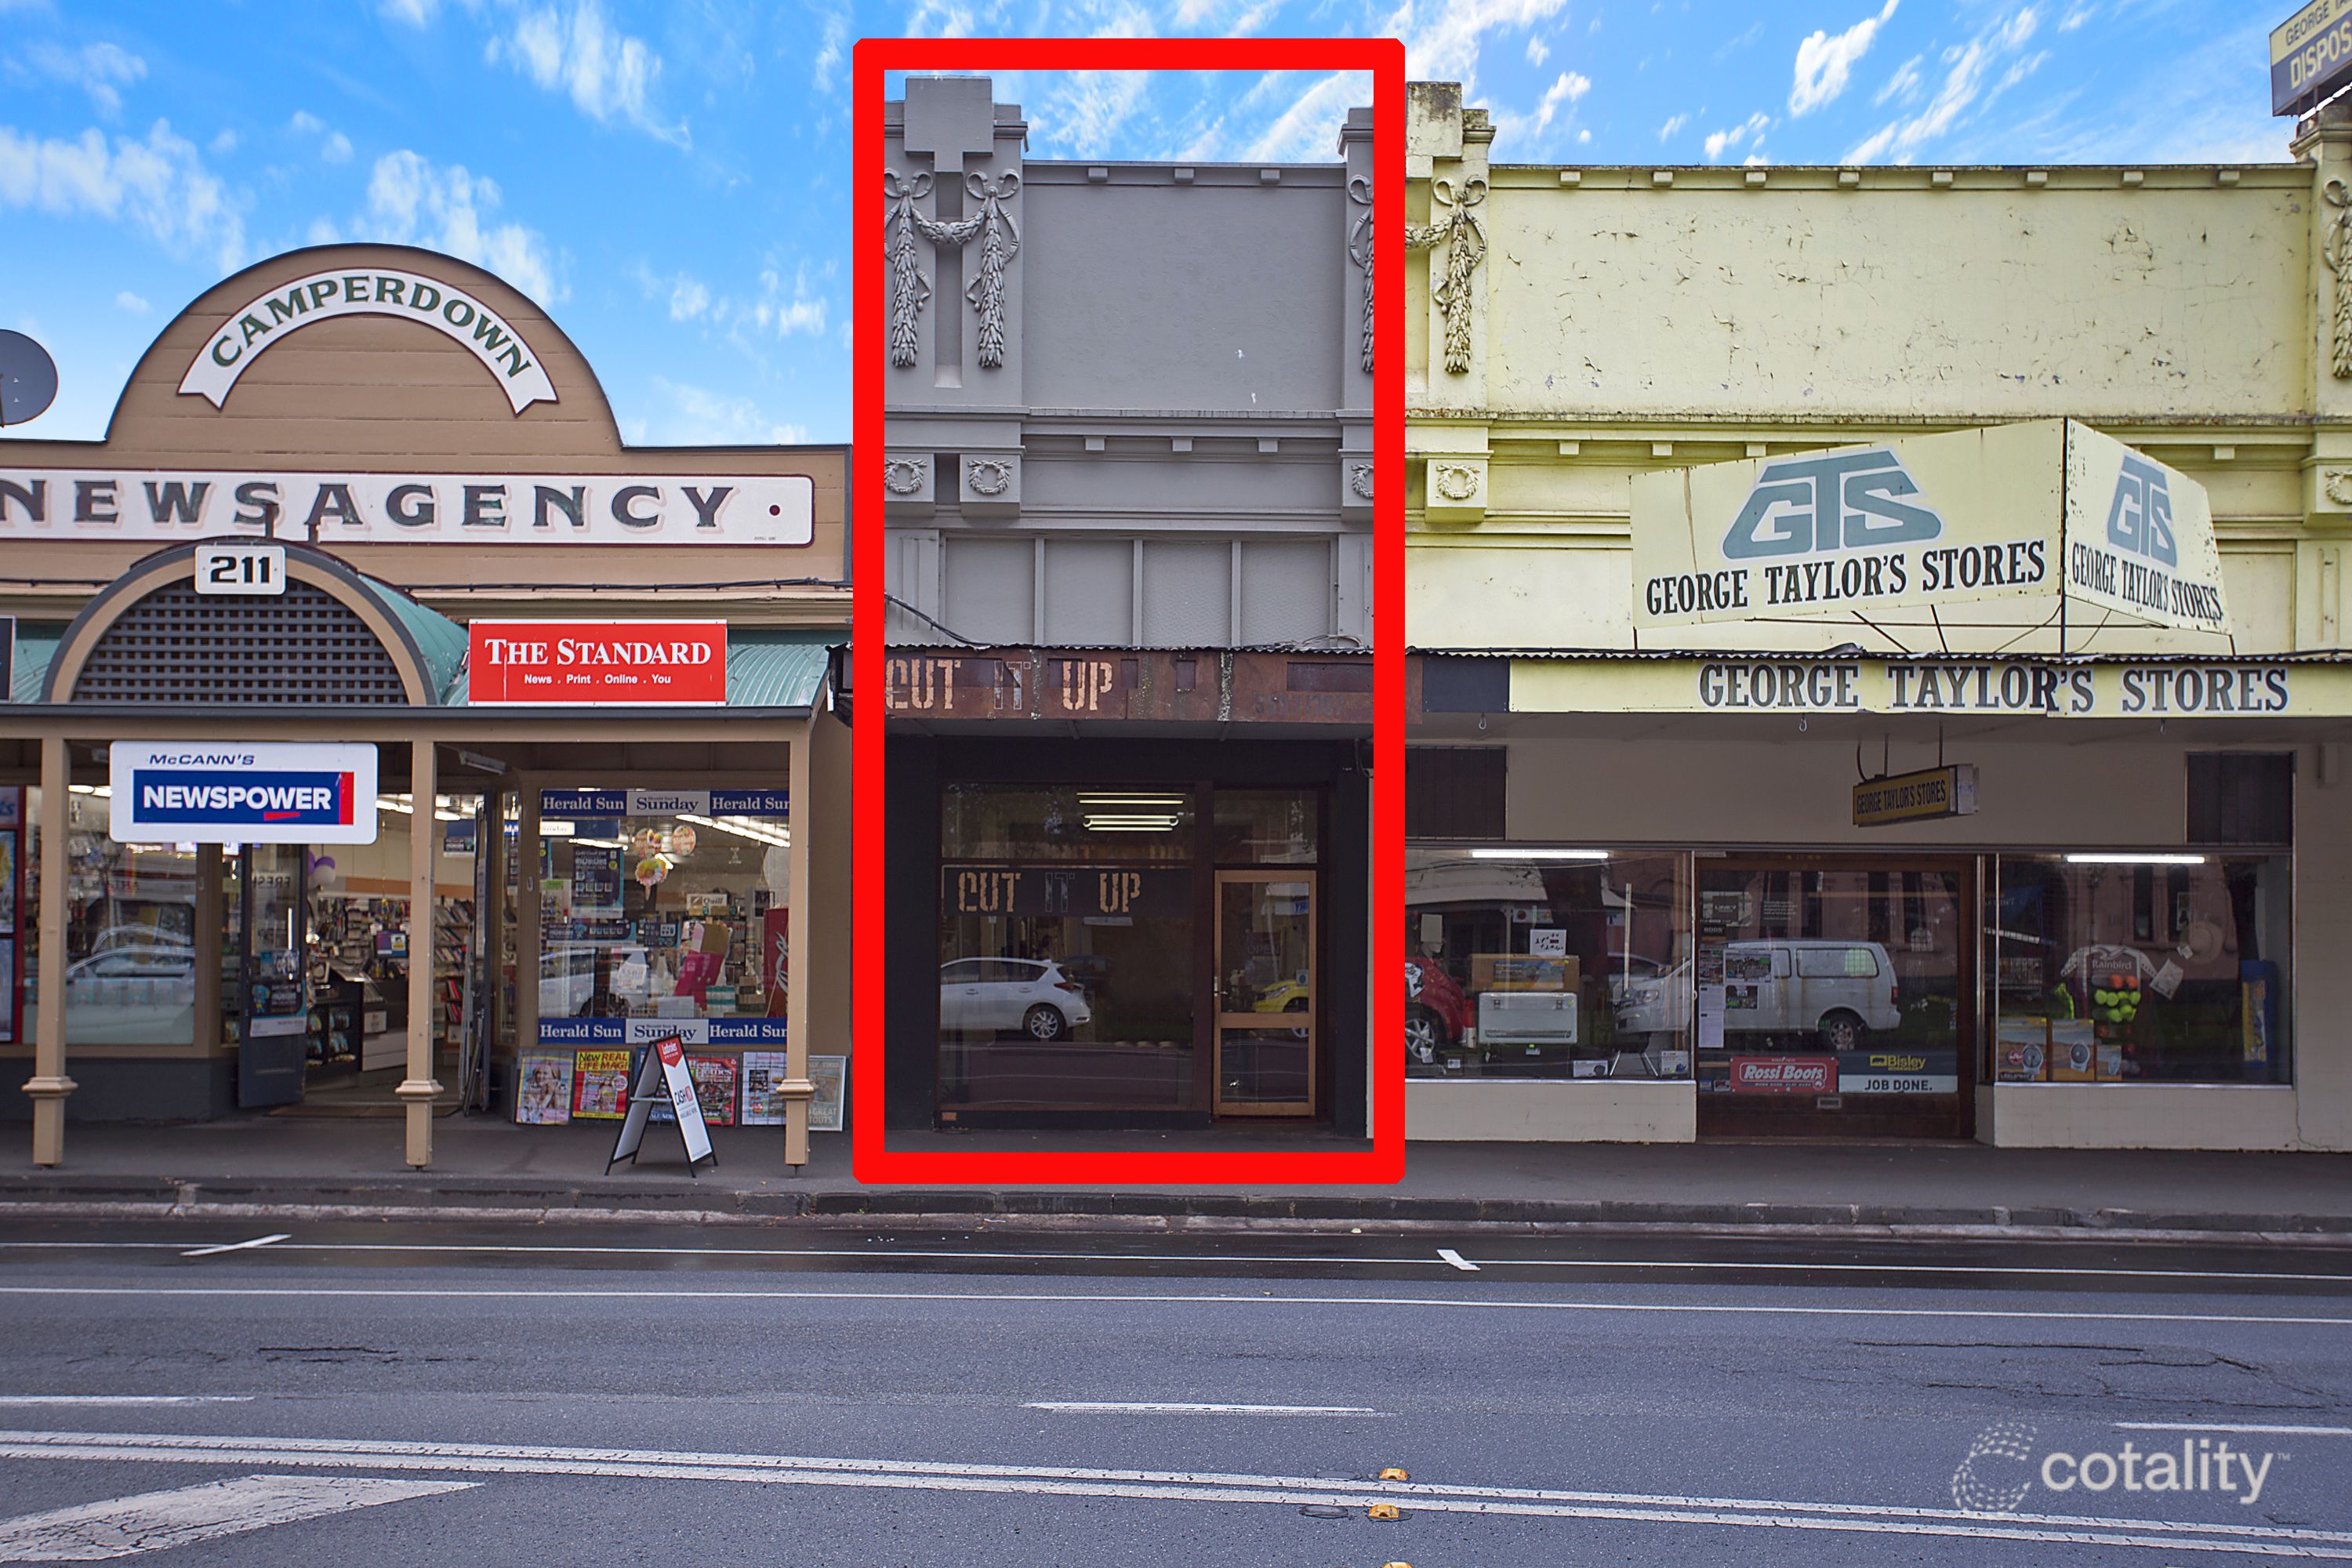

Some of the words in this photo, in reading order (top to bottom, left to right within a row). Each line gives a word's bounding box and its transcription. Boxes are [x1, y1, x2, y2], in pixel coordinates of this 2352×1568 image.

[2285, 1, 2330, 46] GEORGE
[211, 275, 532, 378] CAMPERDOWN
[0, 478, 734, 528] NEWSAGENCY
[1720, 449, 1943, 561] GTS
[2105, 452, 2178, 569] GTS
[209, 556, 270, 584] 211
[1646, 569, 1749, 616] GEORGE
[1765, 553, 1907, 606] TAYLOR'S
[1922, 540, 2045, 592] STORES
[2071, 541, 2118, 597] GEORGE
[2121, 555, 2171, 613] TAYLOR'S
[2171, 579, 2224, 622] STORES
[484, 638, 548, 666] THE
[557, 637, 712, 666] STANDARD
[524, 673, 552, 684] News
[566, 673, 591, 684] Print
[604, 673, 638, 684] Online
[652, 673, 671, 684] You
[885, 659, 962, 710] CUT
[1062, 660, 1113, 711] UP
[1699, 663, 1860, 709] GEORGE
[1888, 665, 2095, 713] TAYLOR'S
[2122, 667, 2288, 713] STORES
[149, 753, 255, 766] McCANN'S
[143, 785, 332, 811] NEWSPOWER
[543, 797, 591, 811] Herald
[596, 797, 624, 811] Sun
[712, 797, 760, 811] Herald
[1856, 792, 1882, 815] GEORGE
[1883, 786, 1915, 811] TAYLOR'S
[1916, 779, 1946, 806] STORES
[636, 797, 699, 813] Sunday
[958, 872, 1022, 913] CUT
[1099, 873, 1142, 913] UP
[1247, 943, 1279, 955] OPEN
[2092, 959, 2132, 970] Rainbird
[539, 1024, 590, 1038] Herald
[593, 1025, 622, 1038] Sun
[633, 1025, 697, 1040] Sunday
[710, 1024, 758, 1038] Herald
[577, 1052, 601, 1062] New
[601, 1052, 627, 1062] REAL
[688, 1059, 721, 1069] Better
[1888, 1054, 1926, 1069] Bisley
[577, 1062, 599, 1070] LIFE
[695, 1067, 733, 1078] Homes
[1743, 1065, 1780, 1080] Rossi
[1782, 1065, 1824, 1080] Boots
[1864, 1079, 1889, 1091] JOB
[1893, 1079, 1933, 1091] DONE.
[813, 1107, 837, 1116] GREAT
